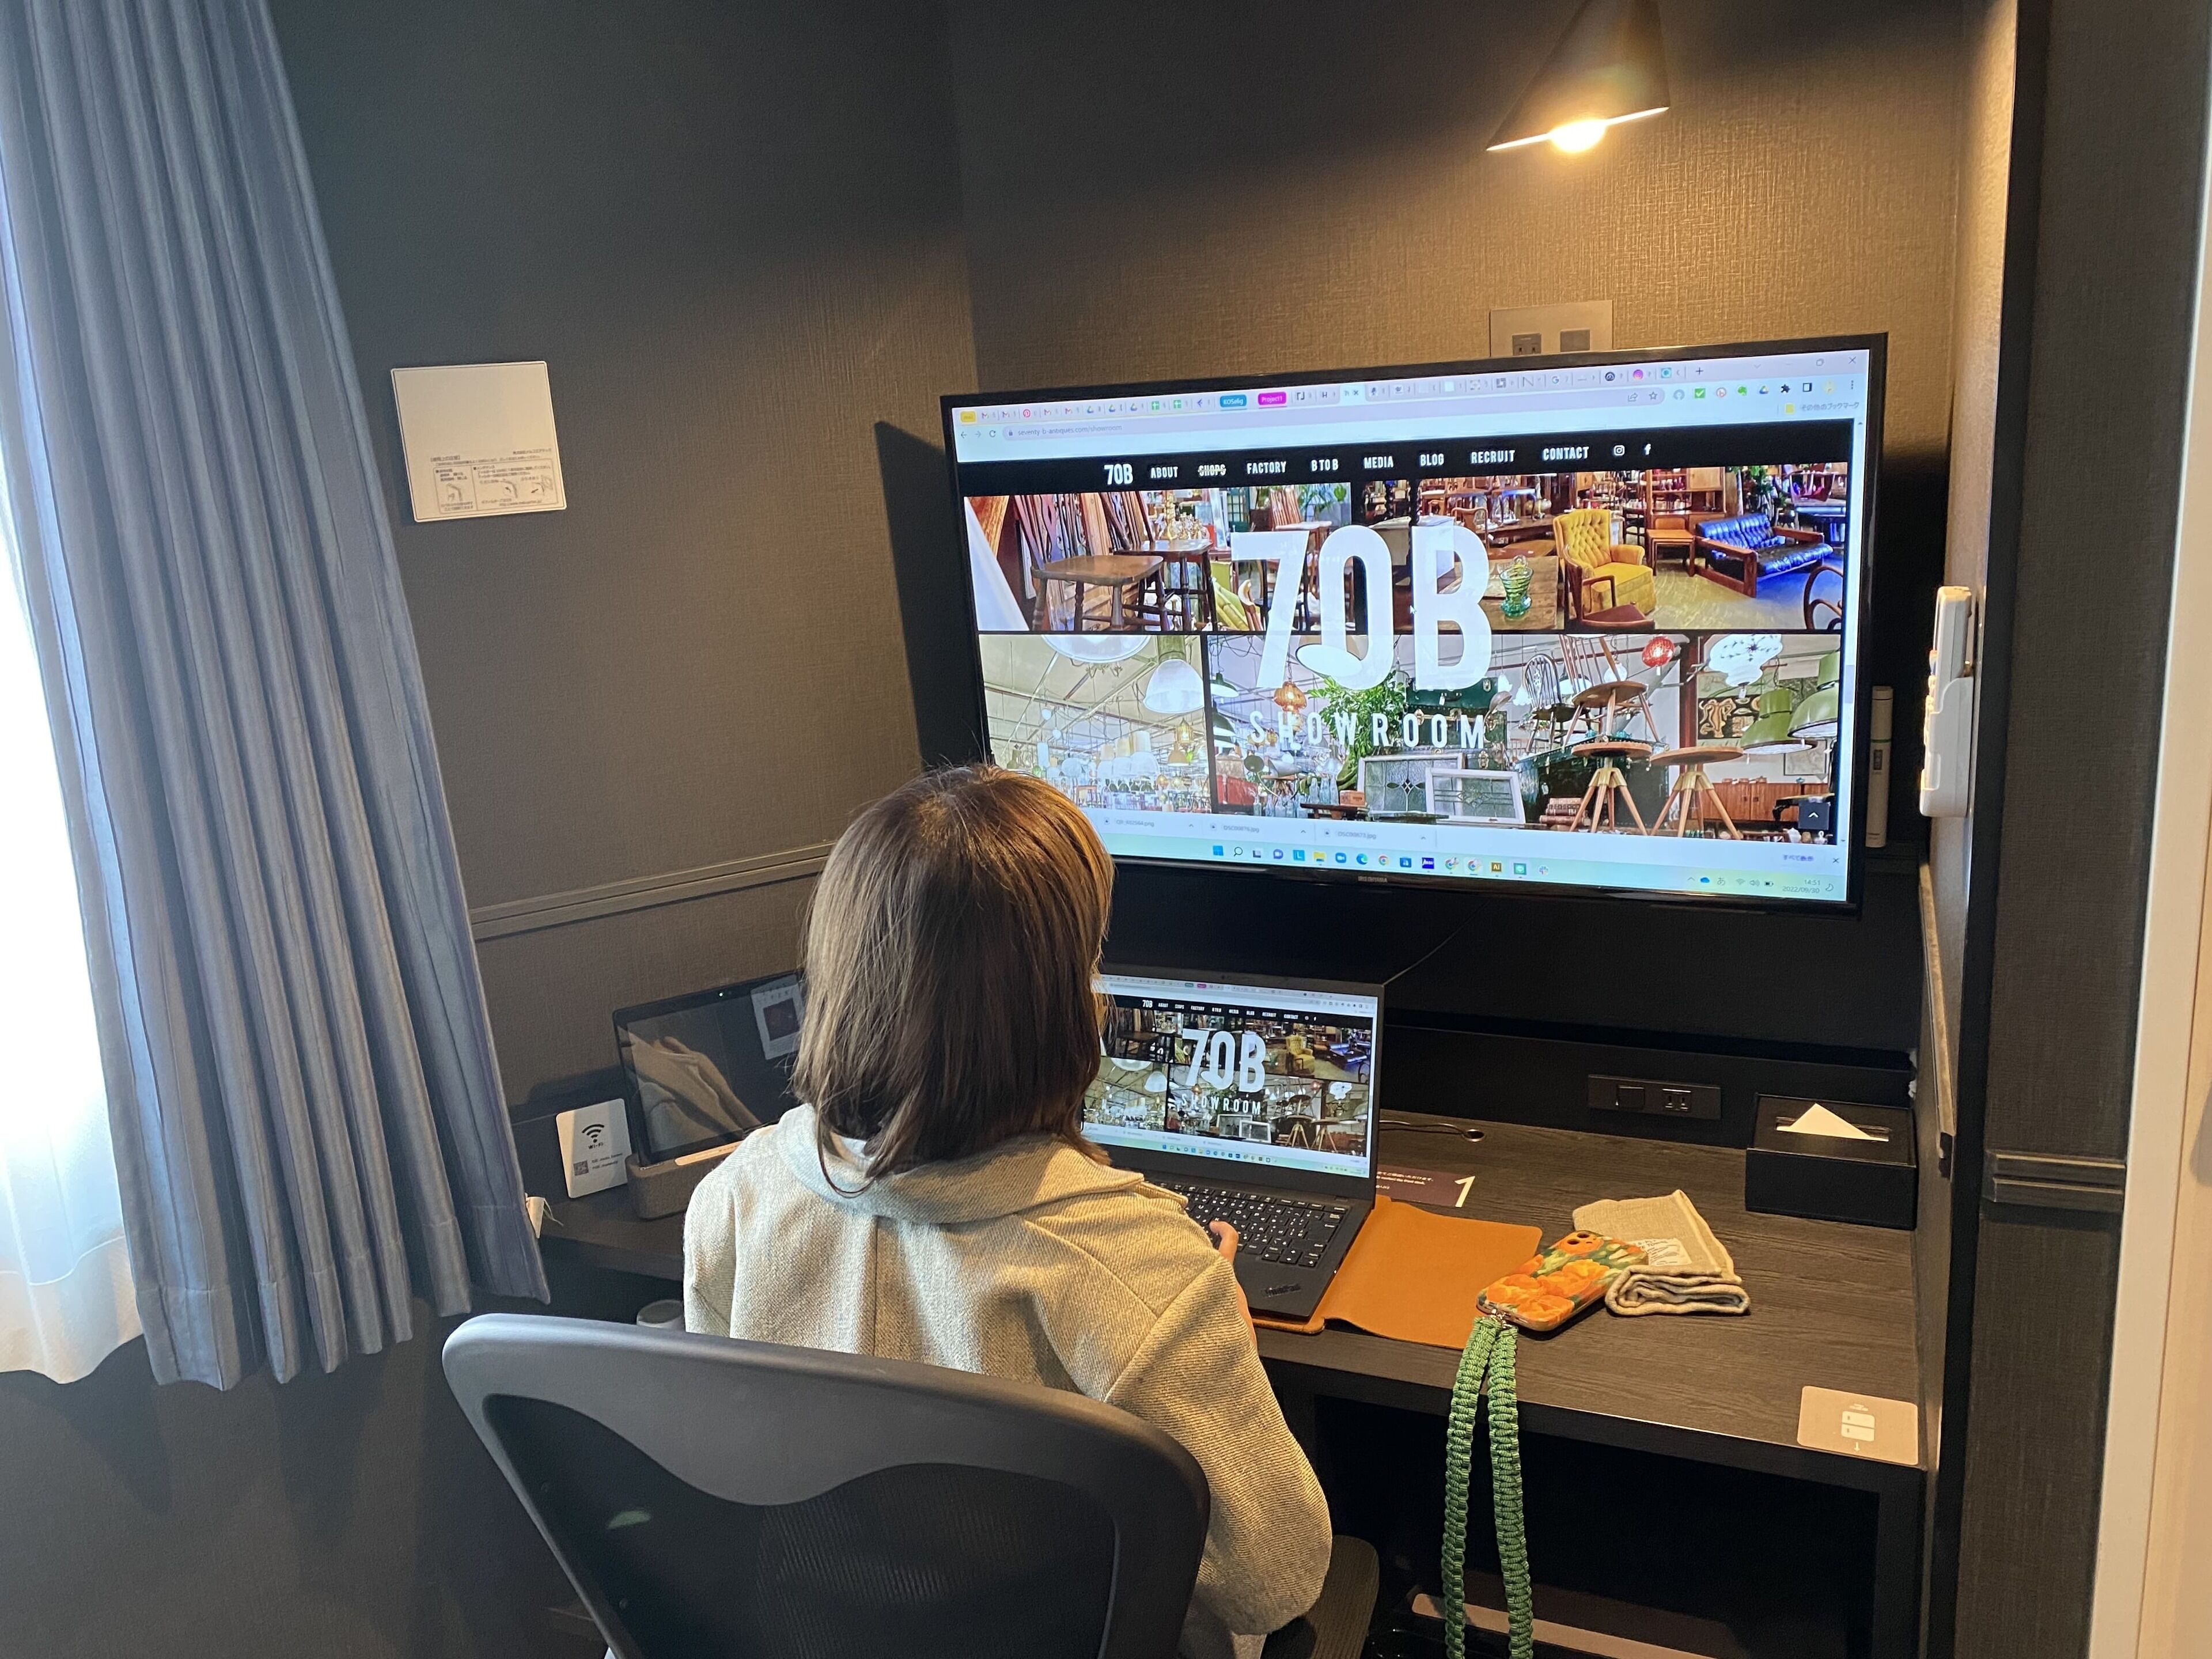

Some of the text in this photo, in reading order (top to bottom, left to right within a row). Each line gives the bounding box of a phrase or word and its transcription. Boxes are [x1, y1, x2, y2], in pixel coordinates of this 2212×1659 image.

[1104, 463, 1134, 485] 70B
[1150, 466, 1179, 479] ABOUT
[1197, 463, 1226, 477] SHOPS
[1247, 461, 1287, 475] FACTORY
[1363, 456, 1394, 469] MEDIA
[1420, 453, 1444, 467] BLOG
[1471, 449, 1516, 464] RECRUIT
[1543, 446, 1590, 461] CONTACT
[1230, 524, 1493, 691] 70B
[1248, 710, 1484, 749] SHOWROOM
[1782, 885, 1820, 893] 2022/09/30
[1142, 999, 1153, 1008] 70B
[1182, 1028, 1266, 1093] 70B
[1181, 1093, 1262, 1115] SHOWROOM
